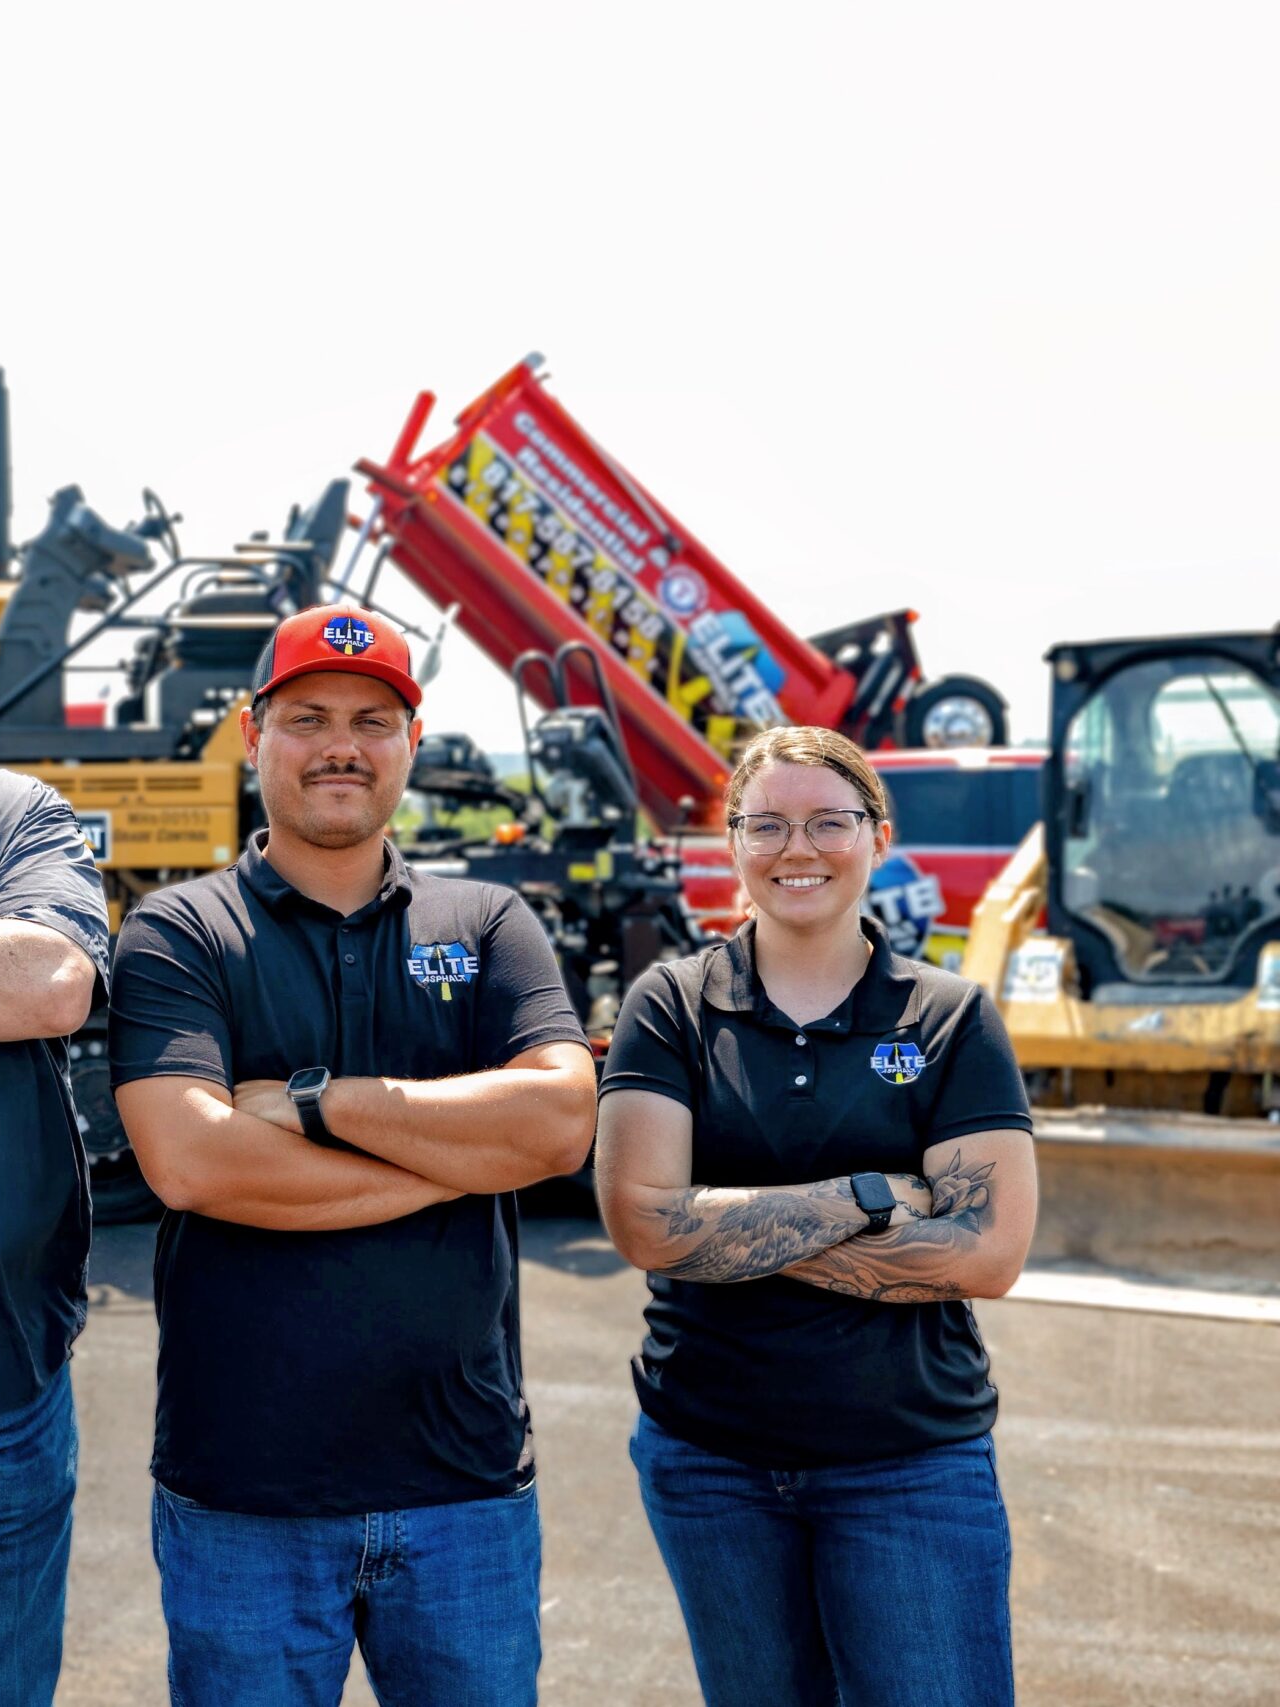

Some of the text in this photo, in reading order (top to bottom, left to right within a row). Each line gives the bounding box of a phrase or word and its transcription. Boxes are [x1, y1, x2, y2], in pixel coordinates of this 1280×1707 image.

[512, 410, 649, 547] Commercial
[517, 447, 645, 575] Residential
[481, 461, 664, 640] 817-587-8158
[323, 627, 375, 643] ELITE
[333, 639, 364, 647] ASPHALT
[407, 956, 479, 975] ELITE
[422, 974, 466, 983] ASPHALT
[870, 1056, 926, 1068] ELITE
